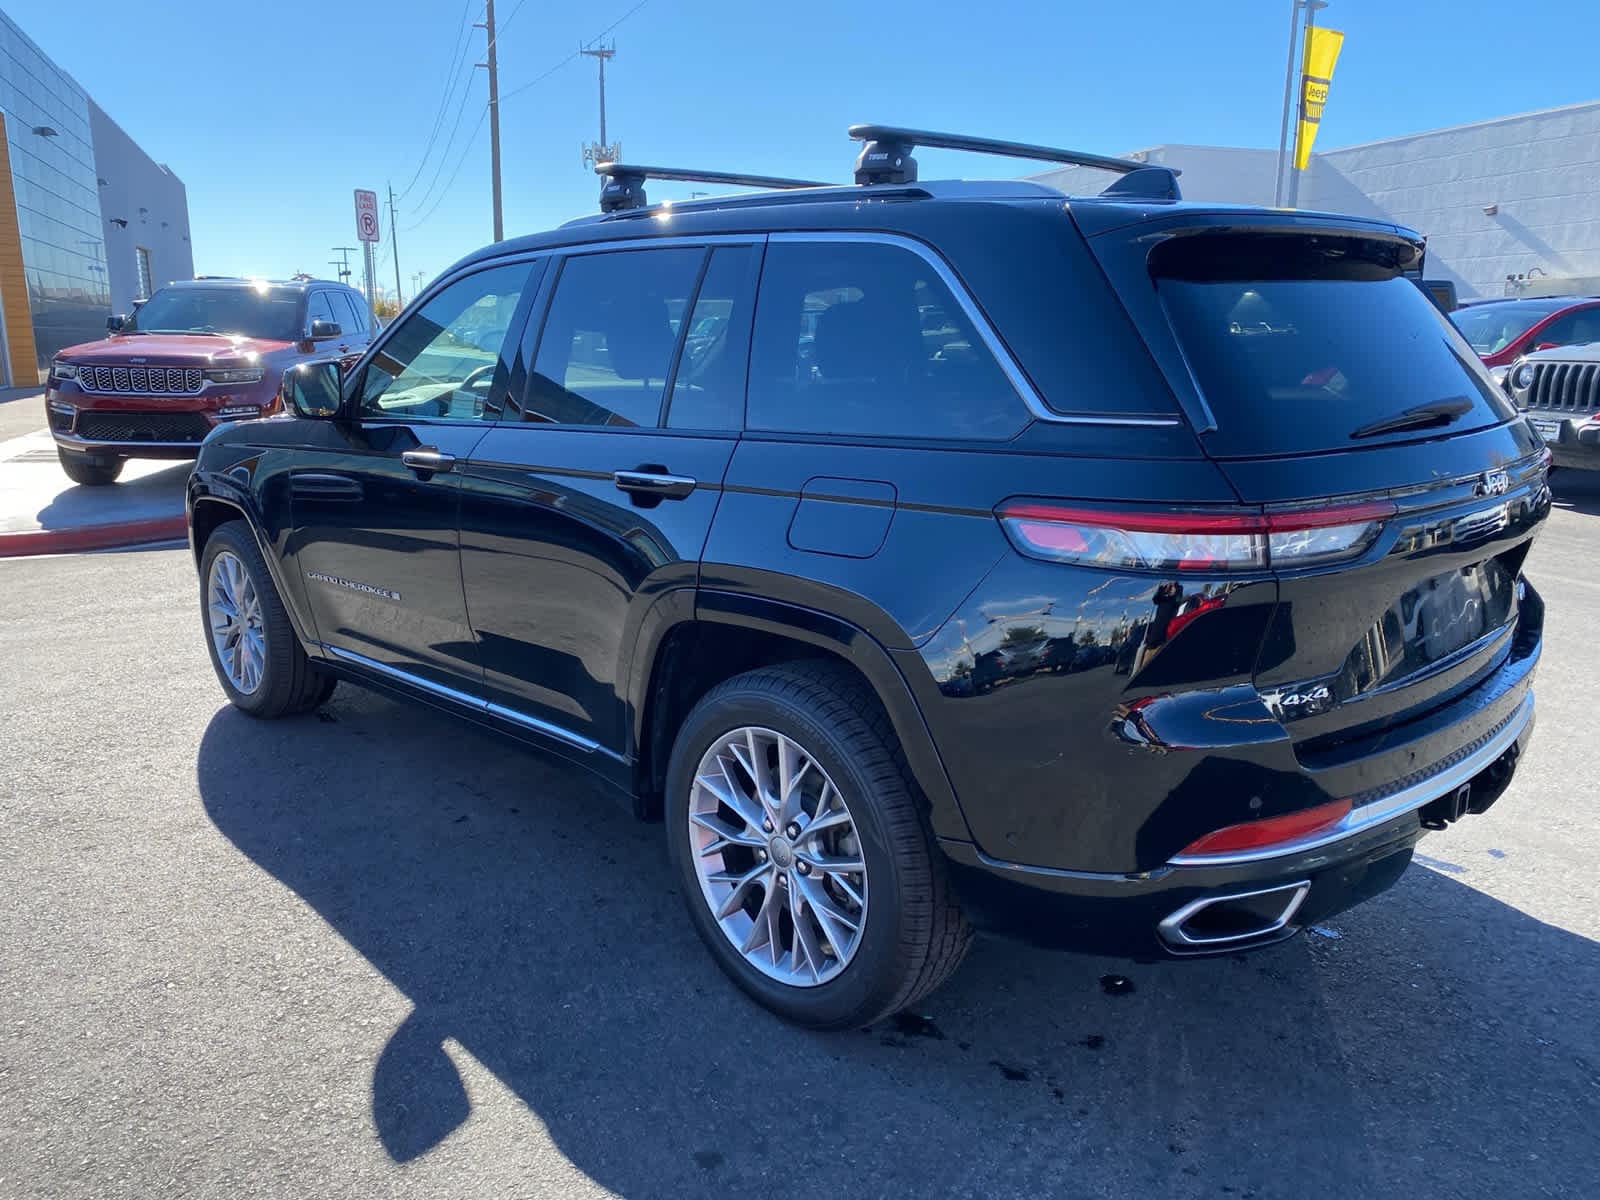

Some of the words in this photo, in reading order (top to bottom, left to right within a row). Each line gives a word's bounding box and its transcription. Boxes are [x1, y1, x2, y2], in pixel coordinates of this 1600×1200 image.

[1307, 85, 1326, 101] Jeep
[1484, 470, 1510, 495] Jeep
[307, 571, 338, 584] GRAND
[339, 579, 391, 597] CHEROKEE
[1281, 686, 1329, 706] 4x4
